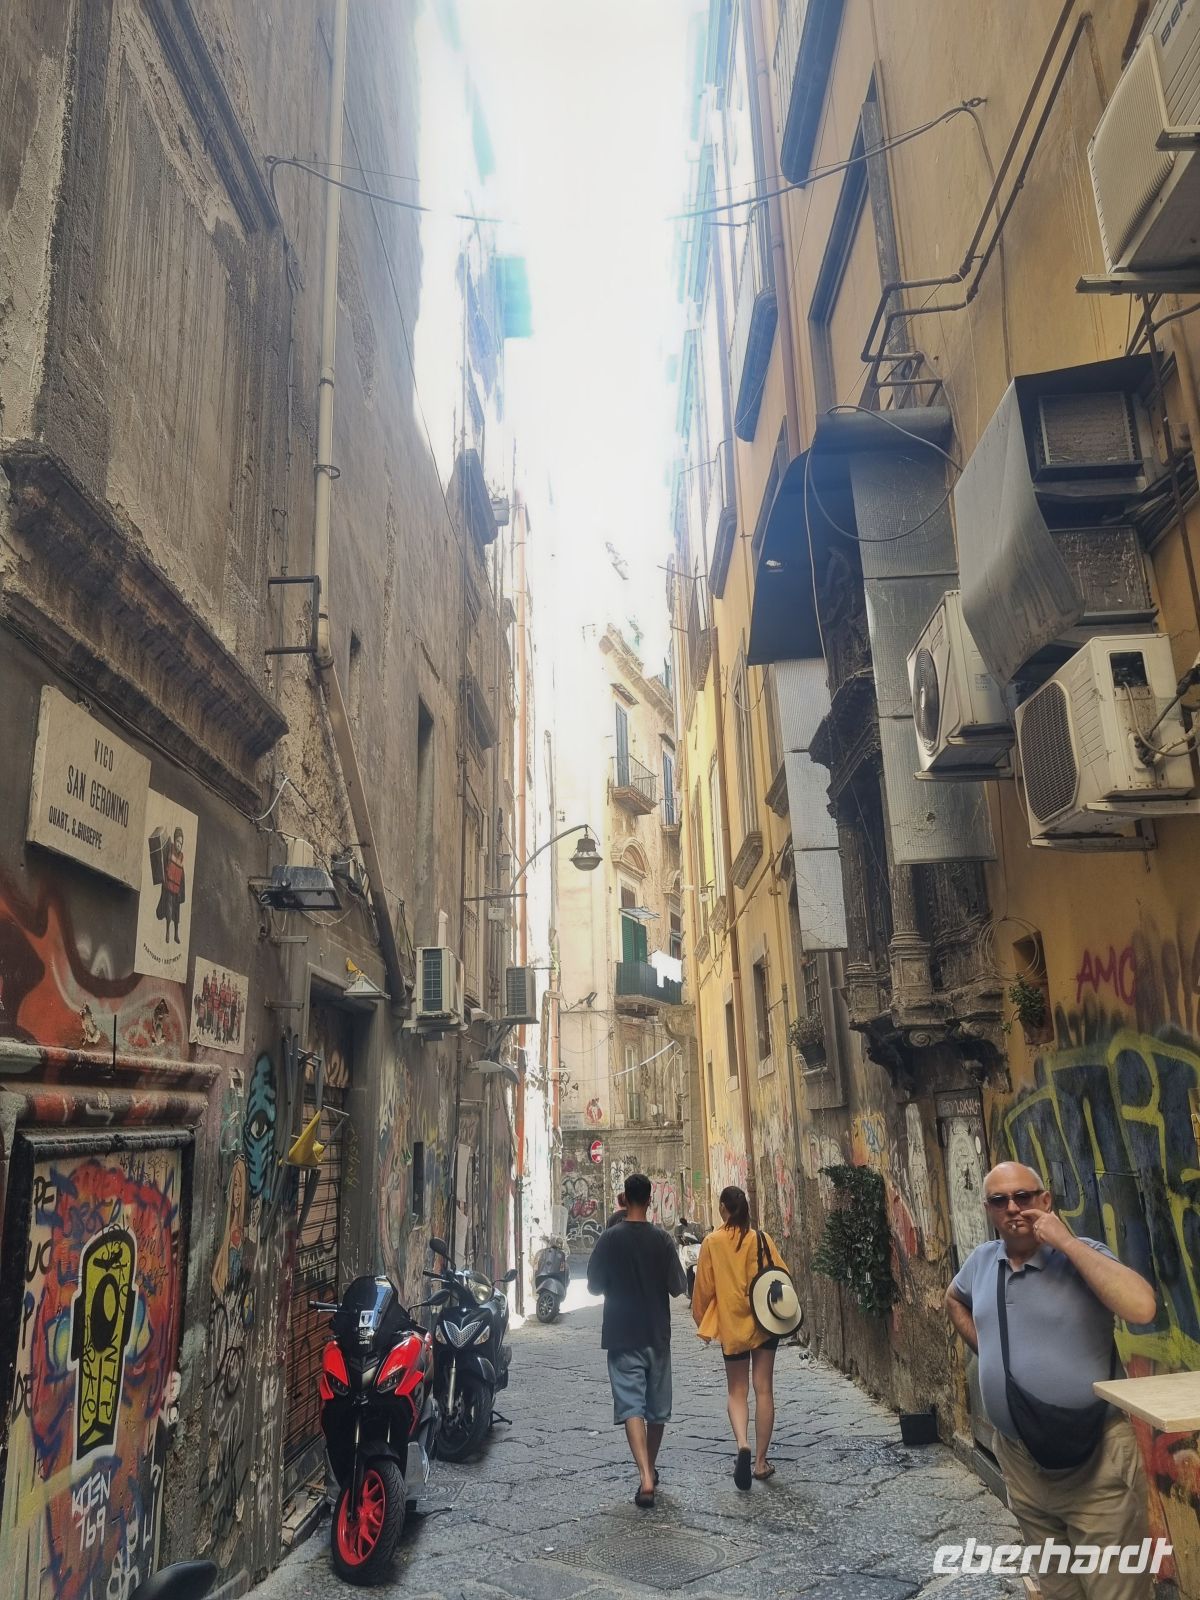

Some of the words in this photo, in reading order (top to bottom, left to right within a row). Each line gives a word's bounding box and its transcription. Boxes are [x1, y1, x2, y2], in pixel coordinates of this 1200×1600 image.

[94, 738, 114, 772] VICO
[66, 764, 87, 803] SAN
[89, 779, 130, 829] GERONIMO
